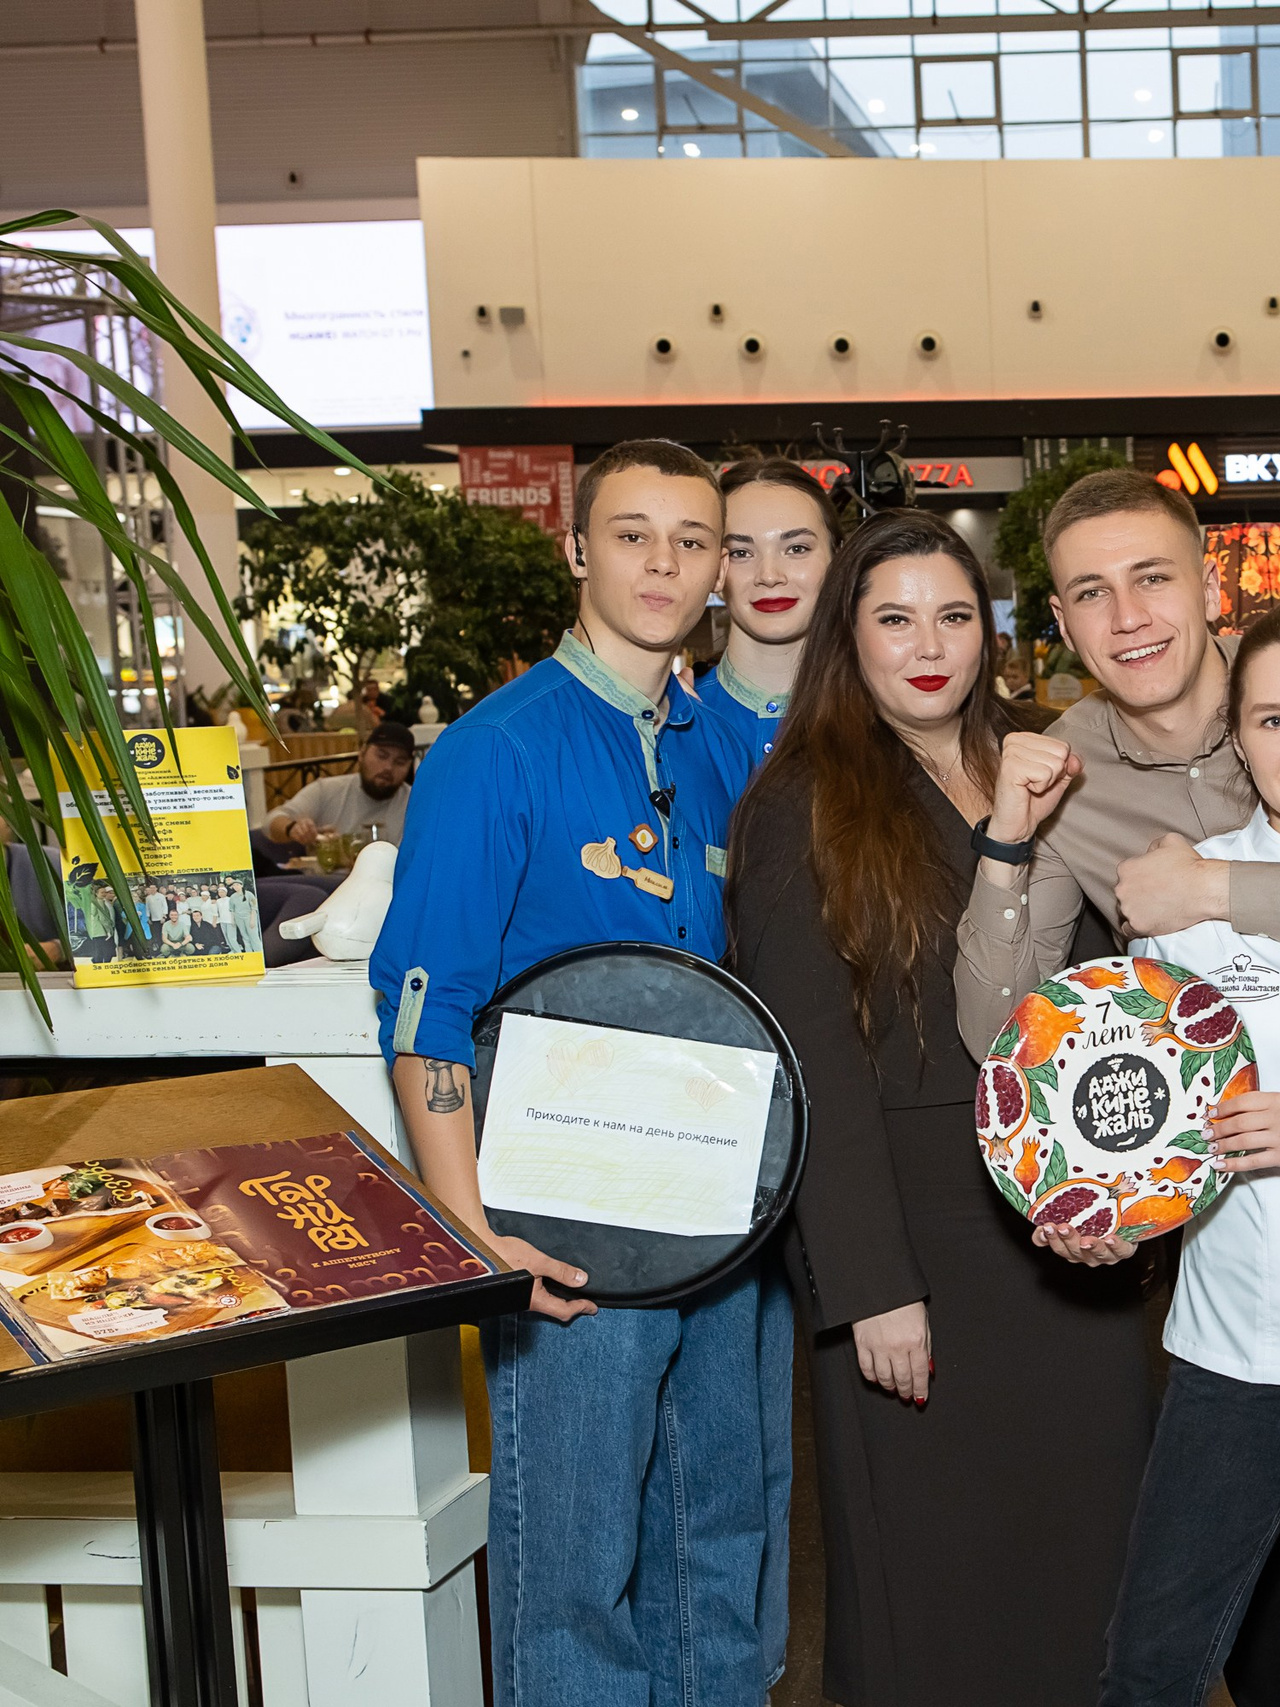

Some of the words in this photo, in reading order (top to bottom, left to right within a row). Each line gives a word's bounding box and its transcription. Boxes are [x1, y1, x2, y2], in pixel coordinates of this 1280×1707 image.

[909, 464, 973, 487] ZZA
[466, 487, 551, 506] FRIENDS
[1221, 974, 1260, 984] Шеф-повар
[1242, 983, 1280, 992] Анастасия
[1095, 1001, 1111, 1024] 7
[1082, 1024, 1136, 1050] лет
[526, 1107, 591, 1127] Приходите
[593, 1117, 601, 1128] к
[602, 1118, 627, 1133] нам
[628, 1123, 645, 1135] на
[645, 1124, 675, 1140] день
[677, 1131, 738, 1149] рождение
